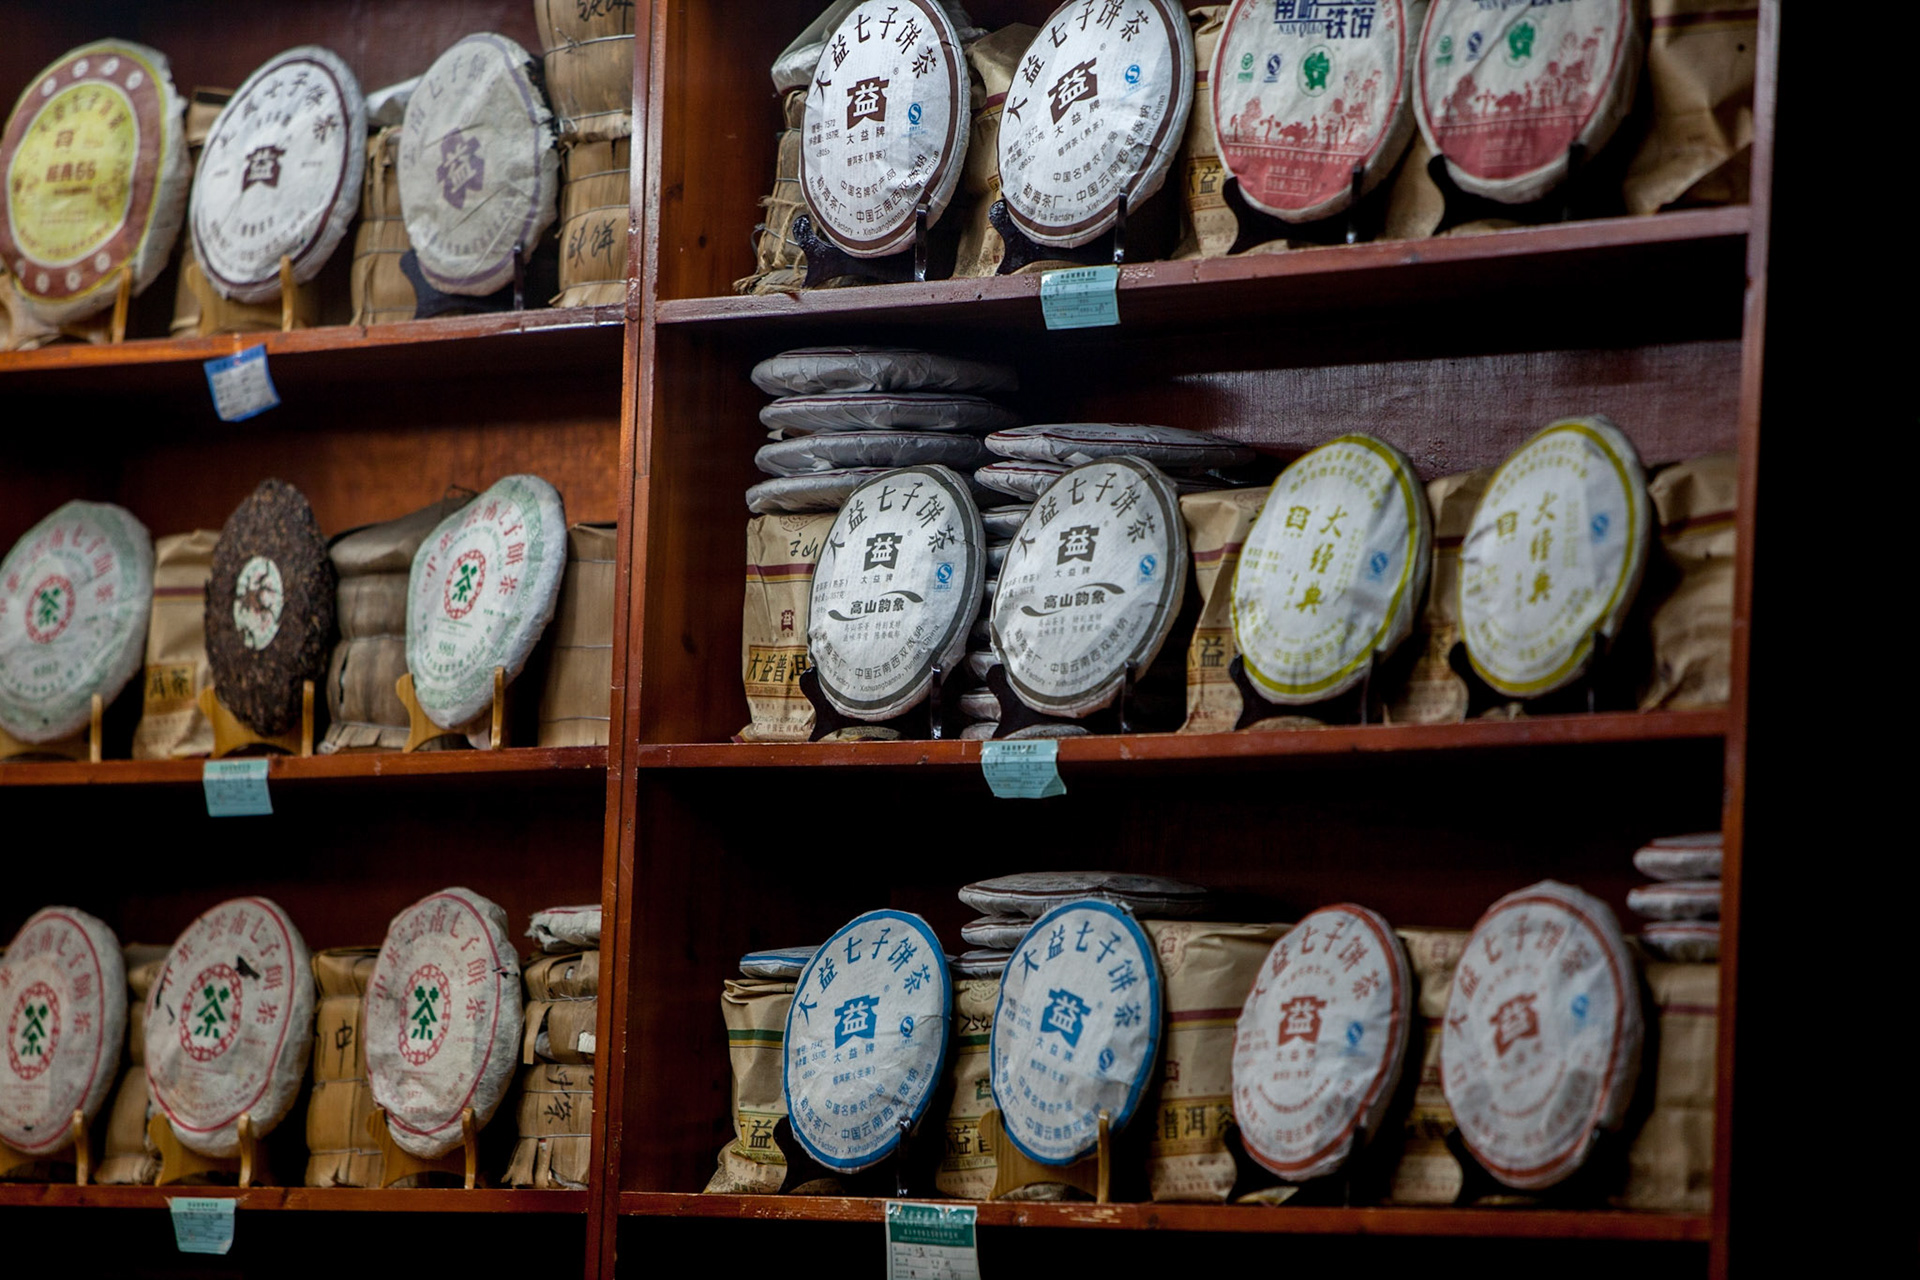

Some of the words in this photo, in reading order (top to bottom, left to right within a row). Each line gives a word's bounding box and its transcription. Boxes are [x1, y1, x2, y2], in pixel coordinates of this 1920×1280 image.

[813, 6, 937, 105] 大益七子饼茶
[1007, 0, 1149, 124] 大益七子饼茶
[846, 126, 886, 145] 大益牌
[1055, 100, 1100, 137] 大益牌
[840, 168, 897, 199] 中国名牌农产品
[1023, 182, 1063, 209] 勐海茶厂
[1077, 104, 1152, 203] 中国云南西双版纳
[1053, 131, 1118, 184] 中国名牌农产品
[856, 153, 928, 223] 中国云南西双版纳
[827, 482, 956, 564] 大益七子饼茶
[1017, 473, 1156, 561] 大益七子饼茶
[850, 597, 905, 615] 高山韵象
[1043, 590, 1107, 609] 高山韵象
[855, 625, 924, 680] 中国云南西双版纳
[798, 927, 931, 1026] 大益七子饼茶
[1018, 920, 1141, 1028] 大益七子饼茶
[833, 1043, 875, 1064] 大益牌
[800, 1095, 831, 1134] 勐海茶厂
[841, 1067, 919, 1141] 中国云南西双版纳
[825, 1083, 886, 1117] 中国名牌农产品
